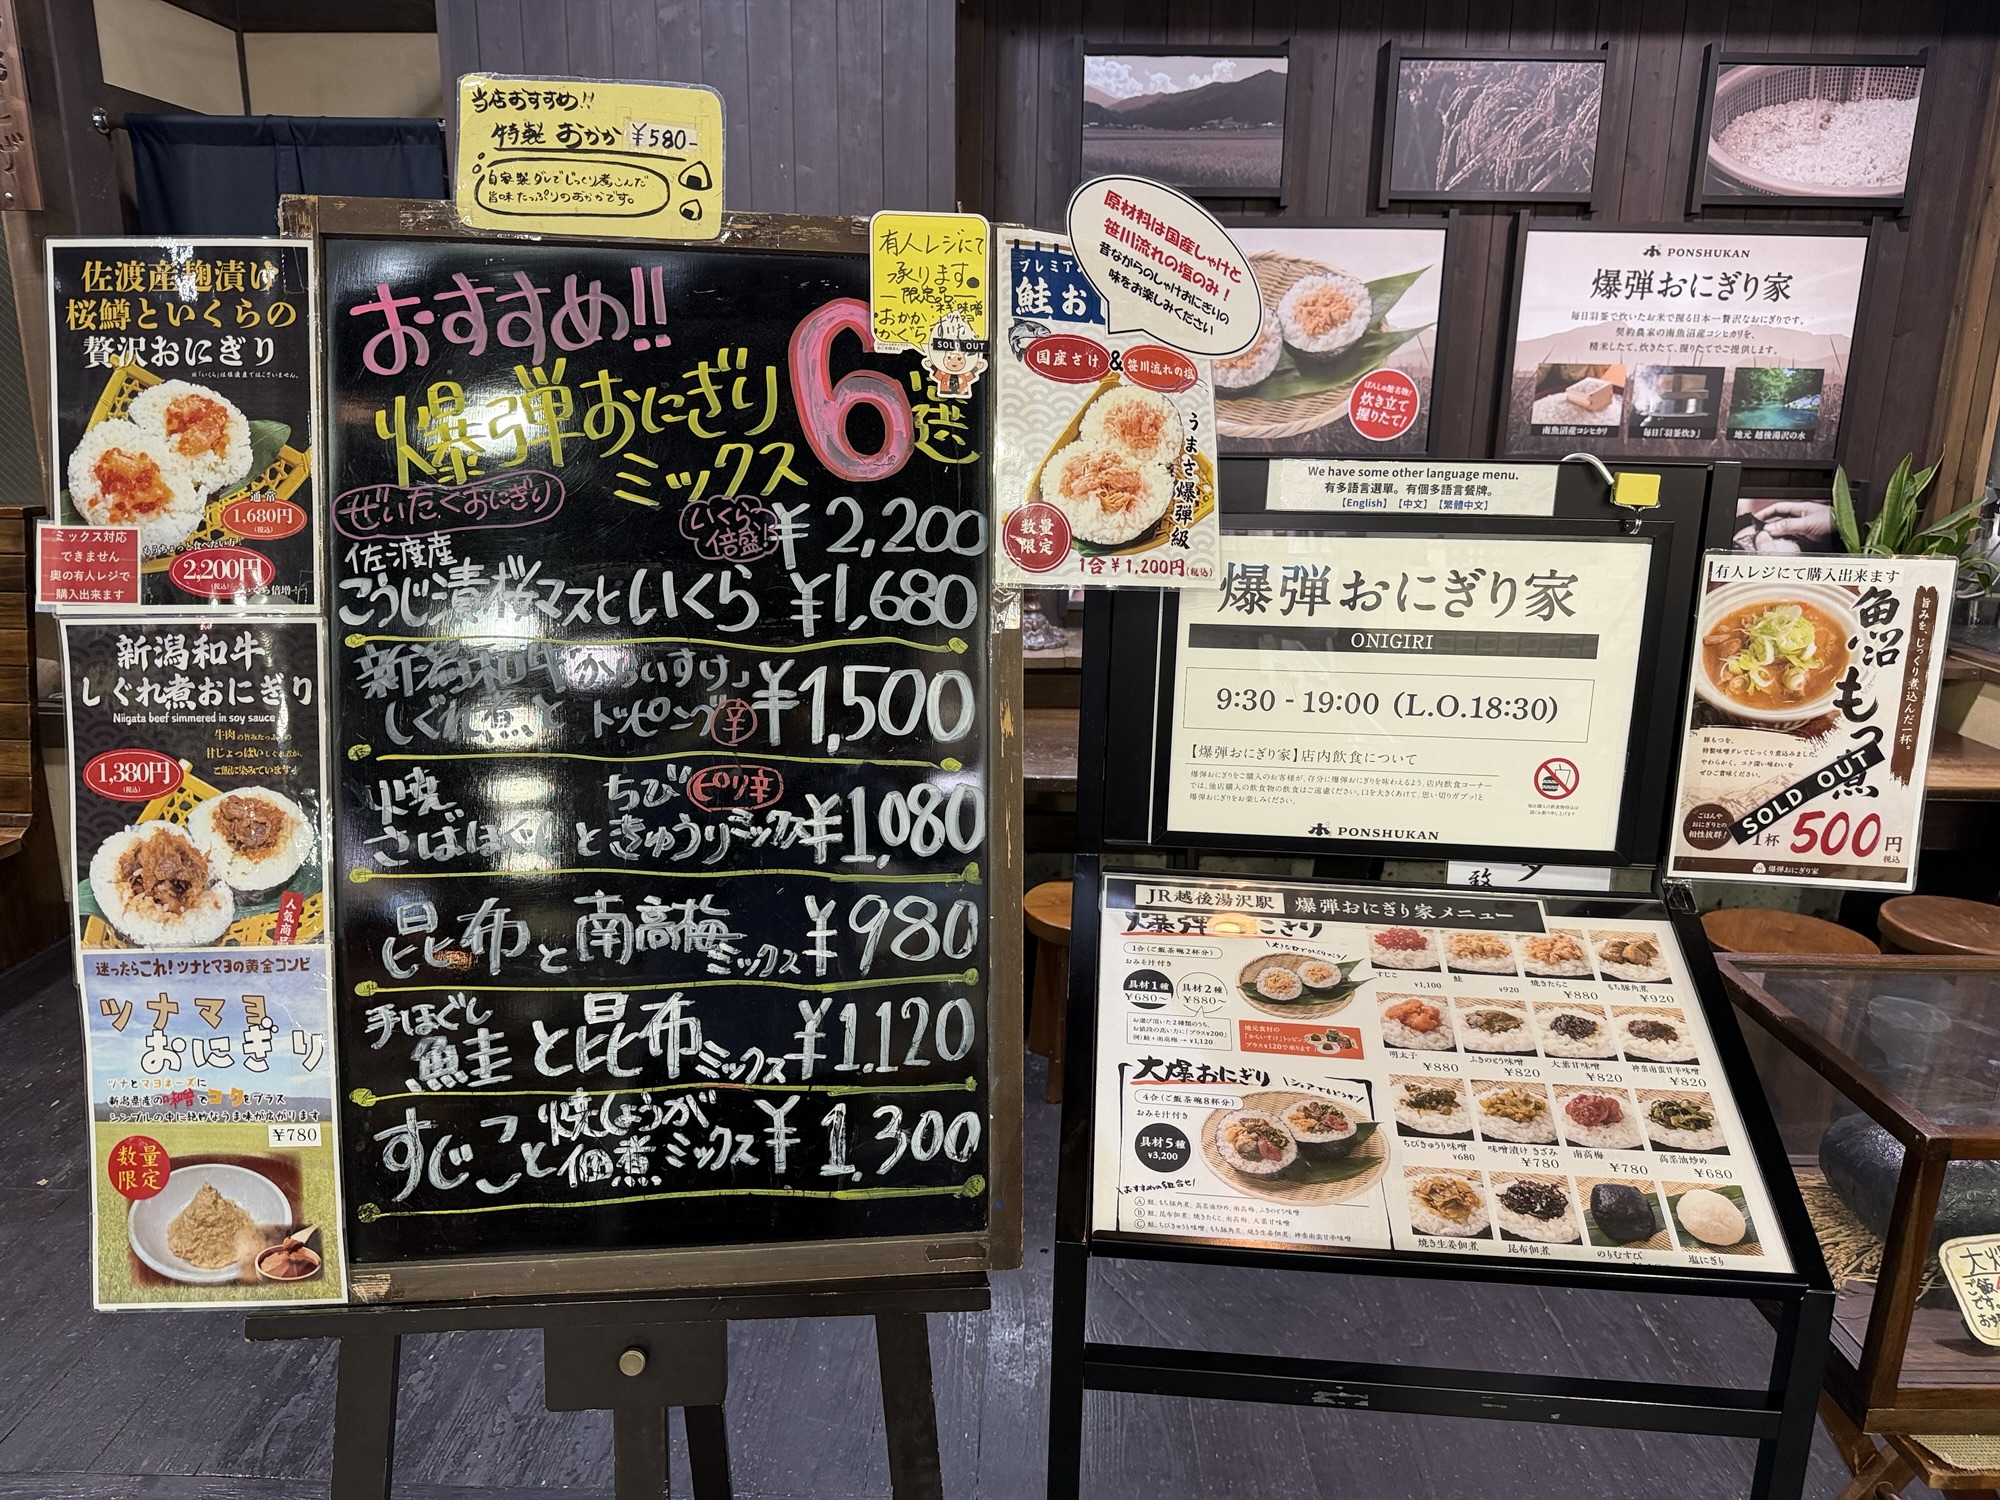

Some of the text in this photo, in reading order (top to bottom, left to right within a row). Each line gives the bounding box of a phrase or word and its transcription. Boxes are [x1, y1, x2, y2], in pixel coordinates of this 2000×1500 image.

[491, 121, 546, 145] 特製
[556, 122, 622, 149] おかか
[878, 230, 985, 255] 有人レジにて
[1103, 190, 1241, 284] 原材料は国産しゃけと
[1667, 248, 1750, 258] PONSHUKAN
[1099, 241, 1229, 326] 昔ながらのしゃけおにぎりの
[1590, 268, 1794, 303] 爆弾おにぎり家
[1108, 270, 1214, 336] 味をお楽しみください
[65, 297, 297, 331] 桜鱒といくらの
[83, 335, 276, 369] 贅沢おにぎり
[966, 342, 985, 350] OUT
[1036, 348, 1099, 368] 国産さけ
[1109, 350, 1124, 371] &
[1127, 358, 1196, 381] 笹川流れの塩
[1359, 391, 1410, 412] 炊き立て
[375, 348, 777, 486] 爆弾おにぎり
[614, 443, 808, 507] ミックス
[1169, 412, 1199, 550] うまさ爆弾級
[1308, 466, 1519, 481] We have some other language menu.
[250, 491, 277, 502] 通常
[338, 478, 551, 531] ぜいたくおにぎり
[233, 508, 293, 524] 1,680円
[55, 530, 127, 542] ミックス対応
[769, 496, 988, 570] ¥2,200
[1020, 518, 1054, 535] 数量
[345, 532, 457, 574] 佐渡産
[1020, 538, 1054, 555] 限定
[61, 551, 120, 563] できません
[49, 570, 131, 582] 奥の有人レジで
[183, 558, 262, 580] 2,200円
[1715, 564, 1900, 584] 有人レジにて購入出来ます
[55, 589, 125, 601] 購入出来ます
[790, 563, 978, 637] ¥1,680
[1217, 562, 1579, 622] 爆弾おにぎり家
[115, 631, 265, 671] 新潟和牛
[1351, 632, 1433, 650] ONIGIRI
[81, 673, 313, 711] しぐれ煮おにぎり
[1217, 688, 1276, 712] 9:30
[1303, 691, 1379, 715] 19:00
[751, 659, 975, 755] ¥1,500
[112, 712, 275, 725] Niigata beef simmered in soy sauce
[1187, 745, 1418, 767] 【爆弾おにぎり家】店内飲食について
[97, 761, 170, 784] 1,380円
[1741, 751, 1870, 834] SOLD OUT
[799, 783, 985, 869] ¥1,080
[1338, 827, 1439, 840] PONSHUKAN
[1790, 810, 1902, 857] 500 円
[1768, 865, 1819, 875] 爆弾おにぎり家
[1146, 889, 1275, 909] JR越後湯沢駅
[278, 898, 297, 945] 人気商品
[804, 895, 979, 976] ¥980
[1375, 970, 1398, 978] すじこ
[1530, 979, 1568, 988] 焼きたらこ
[1563, 990, 1599, 1000] ¥880
[1639, 994, 1675, 1003] ¥920
[100, 992, 268, 1032] ツナマヨ
[141, 1017, 324, 1074] おにぎり
[1389, 1051, 1418, 1060] 明太子
[1132, 1055, 1270, 1087] 大爆おにぎり
[1423, 1062, 1459, 1072] ¥880
[1504, 1067, 1540, 1078] ¥820
[107, 1077, 207, 1088] ツナとマヨネーズに
[1586, 1072, 1623, 1083] ¥820
[1669, 1076, 1707, 1088] ¥820
[108, 1088, 286, 1109] 新潟県産の味噌でコクをプラス
[109, 1110, 320, 1122] シンプルの中に絶妙なうま味が広がります
[272, 1127, 317, 1142] ¥780
[1140, 1136, 1186, 1149] 具材5種
[118, 1145, 162, 1167] 数量
[1147, 1151, 1178, 1161] ¥3,200
[1453, 1153, 1475, 1161] ¥680
[1521, 1157, 1560, 1169] ¥780
[1573, 1150, 1604, 1160] 南高梅
[1609, 1162, 1648, 1175] ¥780
[1694, 1168, 1733, 1180] ¥680
[118, 1169, 162, 1190] 限定
[1597, 1250, 1643, 1260] のりむすび
[1688, 1255, 1725, 1266] 塩にぎり
